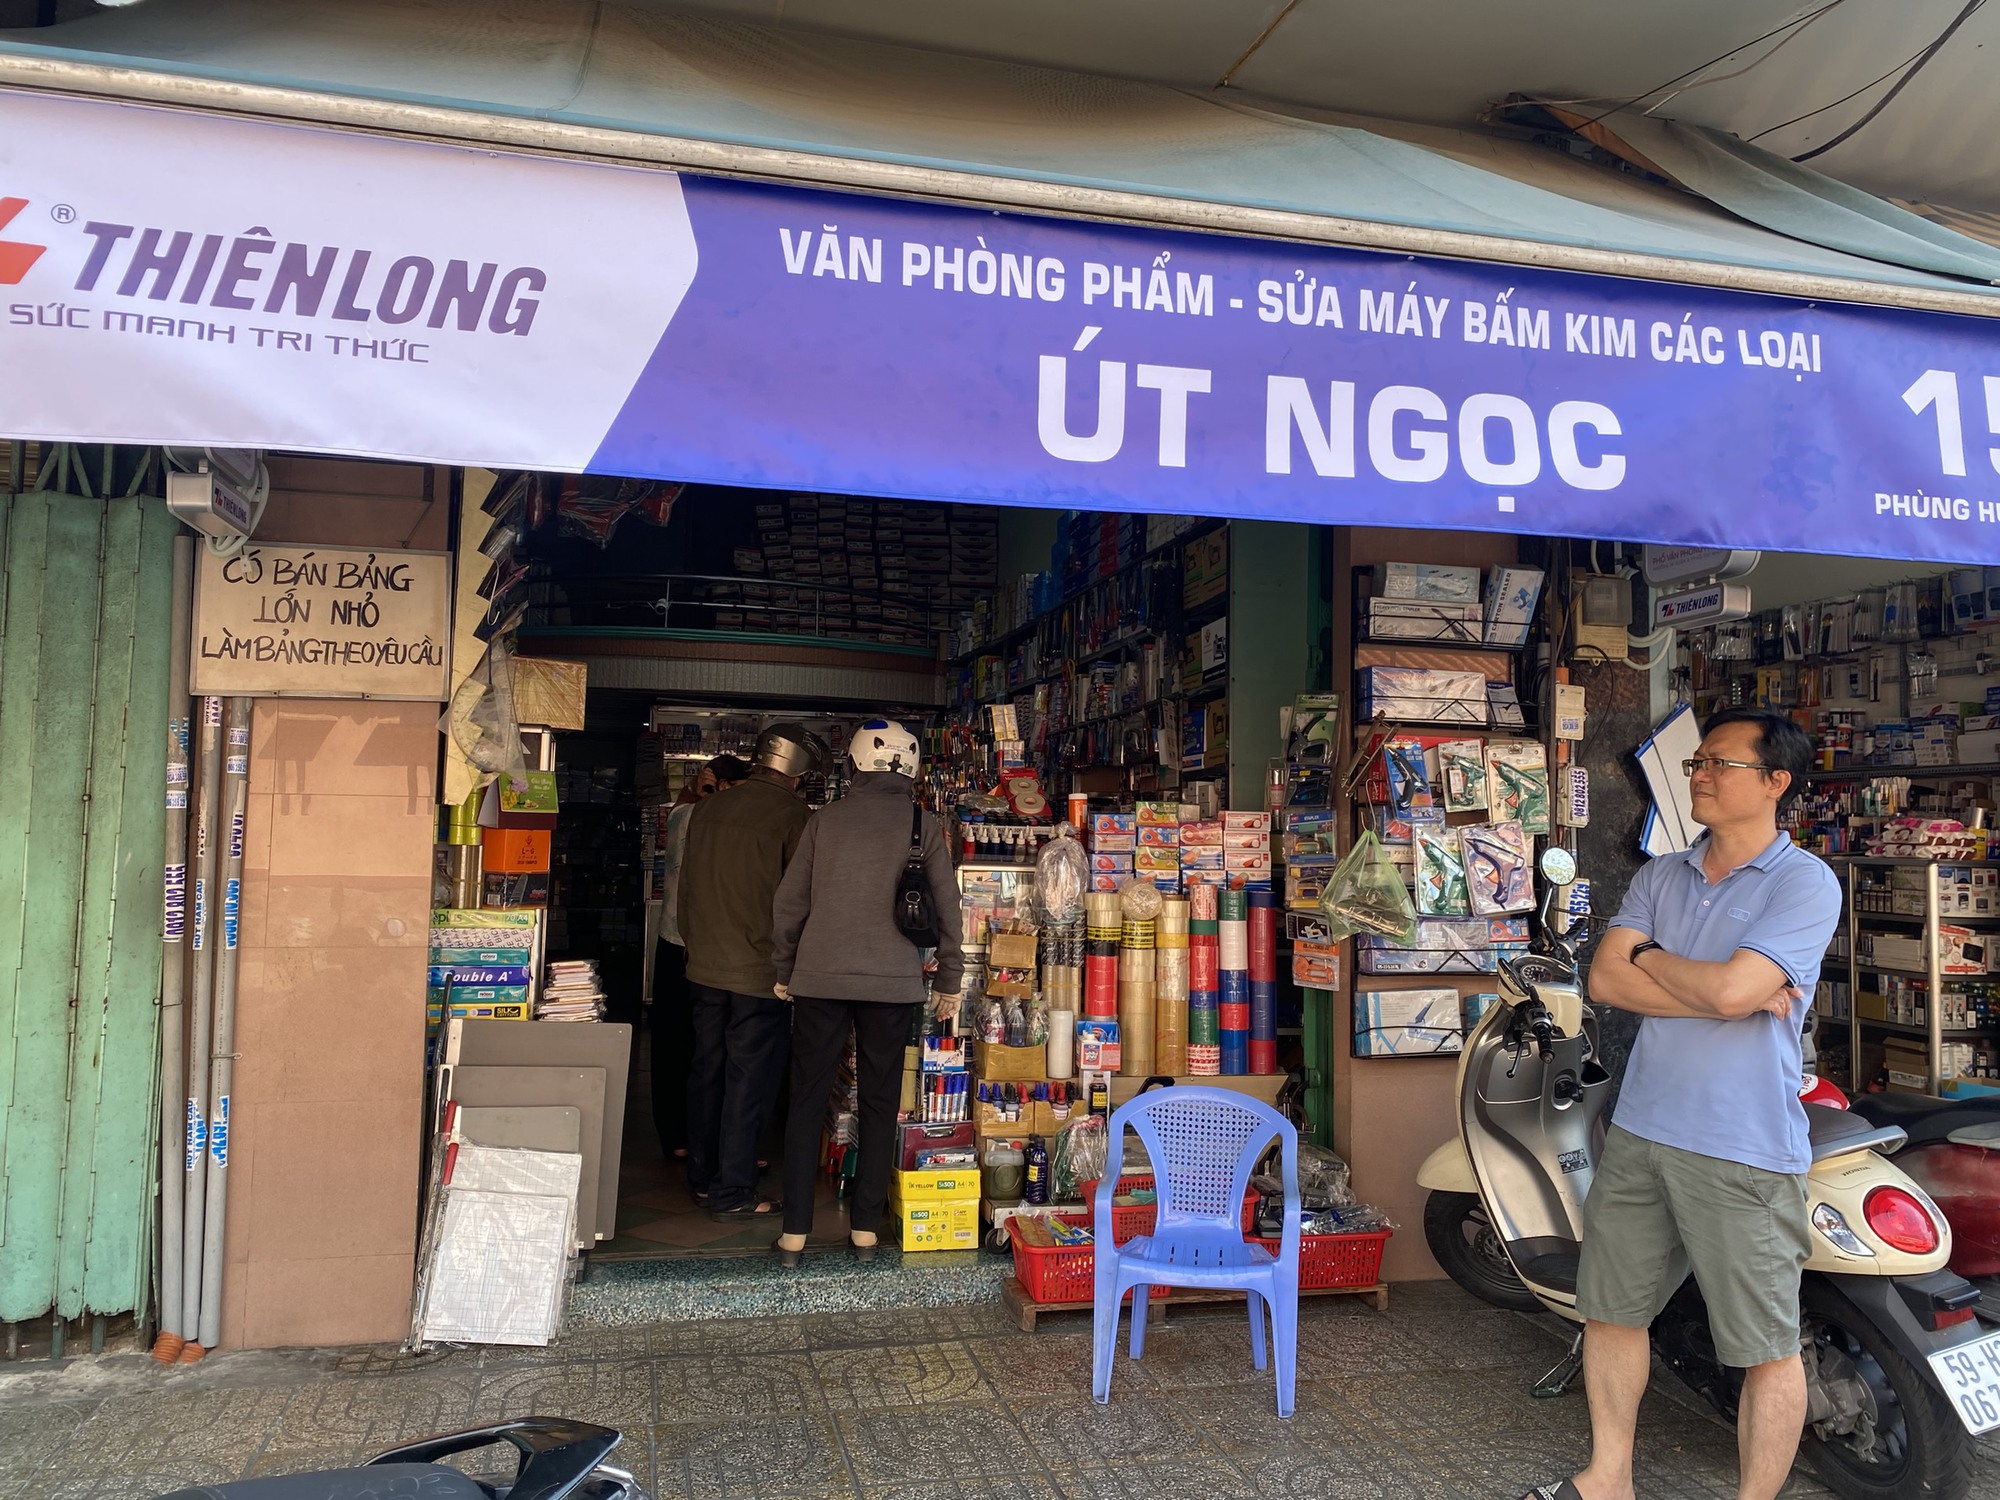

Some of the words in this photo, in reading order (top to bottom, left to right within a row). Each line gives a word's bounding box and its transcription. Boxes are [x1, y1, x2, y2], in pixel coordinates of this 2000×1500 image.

[73, 220, 547, 337] THIÊNLONG
[779, 224, 882, 284] VĂN
[902, 235, 1066, 302] PHÒNG
[1083, 250, 1214, 317] PHẨM
[1229, 298, 1244, 308] -
[1258, 269, 1344, 329] SỬA
[1359, 281, 1450, 339] MÁY
[1464, 287, 1551, 351] BẤM
[1565, 312, 1636, 359] KIM
[1650, 312, 1725, 365] CÁC
[1738, 329, 1822, 382] LOẠI
[9, 302, 90, 329] SỨC
[248, 327, 312, 353] TRI
[325, 335, 431, 364] THỨC
[1037, 325, 1212, 468] ÚT
[1265, 374, 1627, 513] NGỌC
[1901, 369, 2000, 476] 1
[1875, 488, 1971, 521] PHÙNG
[1978, 501, 2000, 523] H
[273, 552, 327, 586] BÁN
[333, 554, 415, 592] BẢNG
[253, 588, 312, 624] LỚN
[330, 592, 380, 628] NHỎ
[497, 971, 508, 982] A
[1841, 1166, 1871, 1177] HONDA
